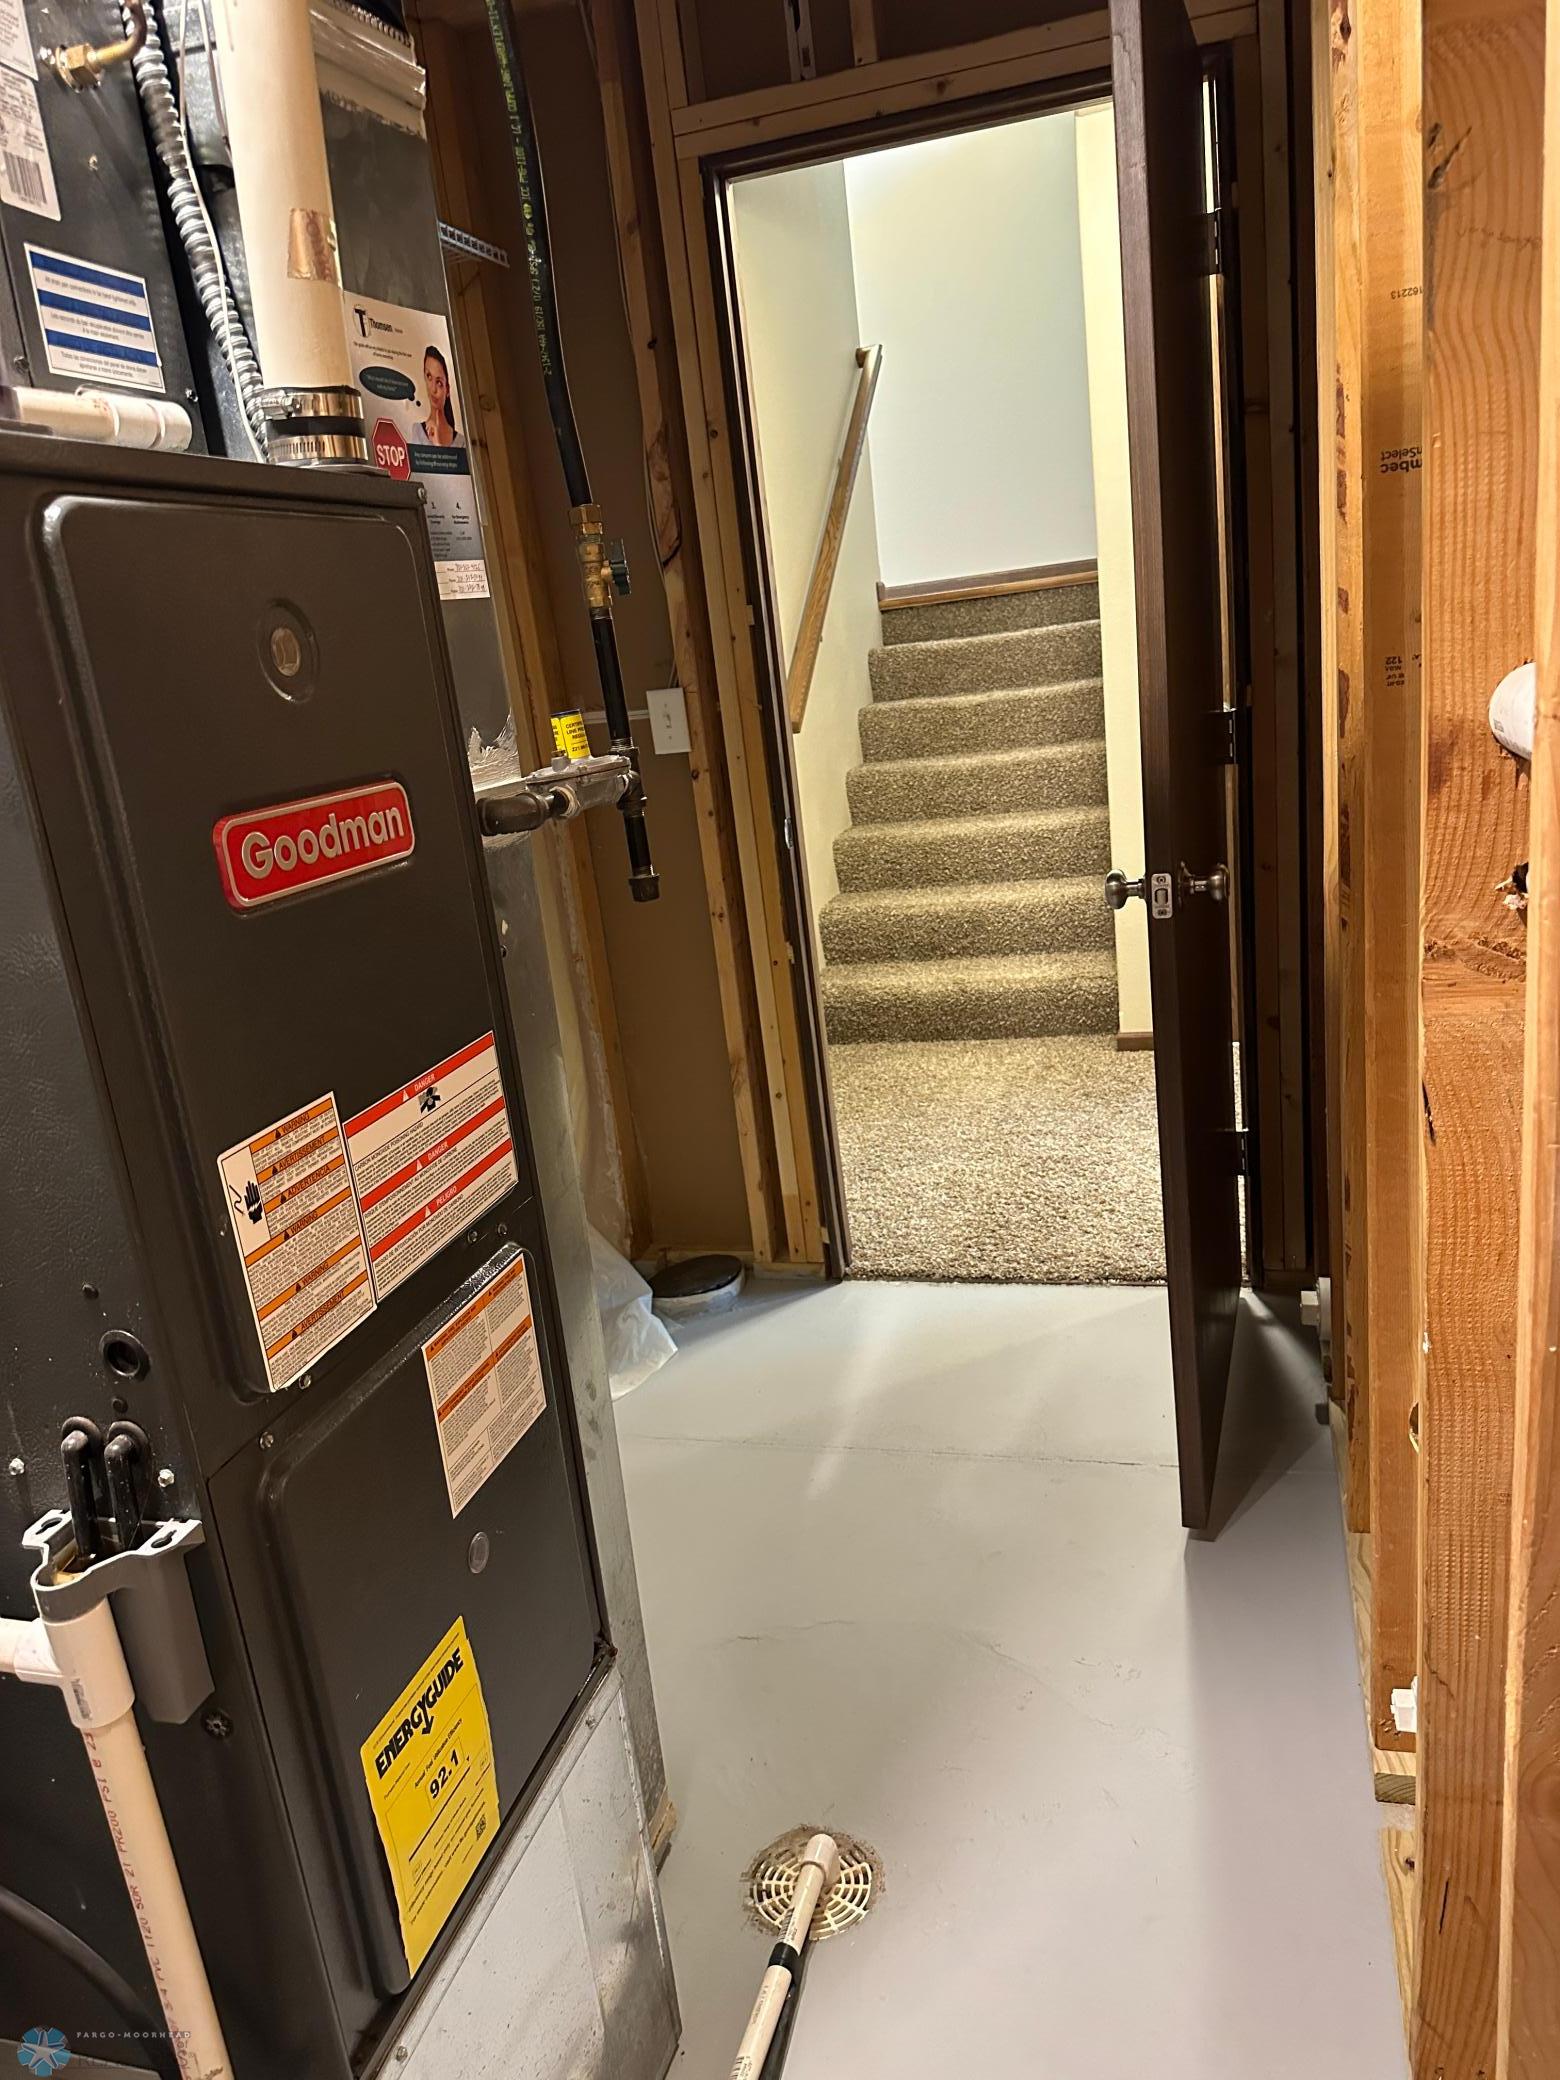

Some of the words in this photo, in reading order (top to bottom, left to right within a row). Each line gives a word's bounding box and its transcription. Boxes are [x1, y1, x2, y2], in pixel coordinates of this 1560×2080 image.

[377, 444, 405, 467] STOP
[241, 806, 405, 879] Goodman
[414, 1073, 435, 1091] DANGER
[281, 1111, 309, 1135] WARNING
[278, 1135, 325, 1170] AVERTISSEMENT
[427, 1140, 448, 1161] DANGER
[287, 1163, 330, 1197] ADVERTENCIA
[436, 1184, 456, 1206] PELIGRO
[290, 1210, 317, 1235] WARNING
[301, 1261, 328, 1286] WARNING
[299, 1289, 345, 1331] AVERTISSEMENT
[375, 1647, 465, 1779] ENERGYGUIDE
[429, 1749, 460, 1799] 92.1
[97, 1777, 111, 1804] PSI
[107, 1809, 127, 1853] PR200
[139, 1917, 156, 1948] 1120
